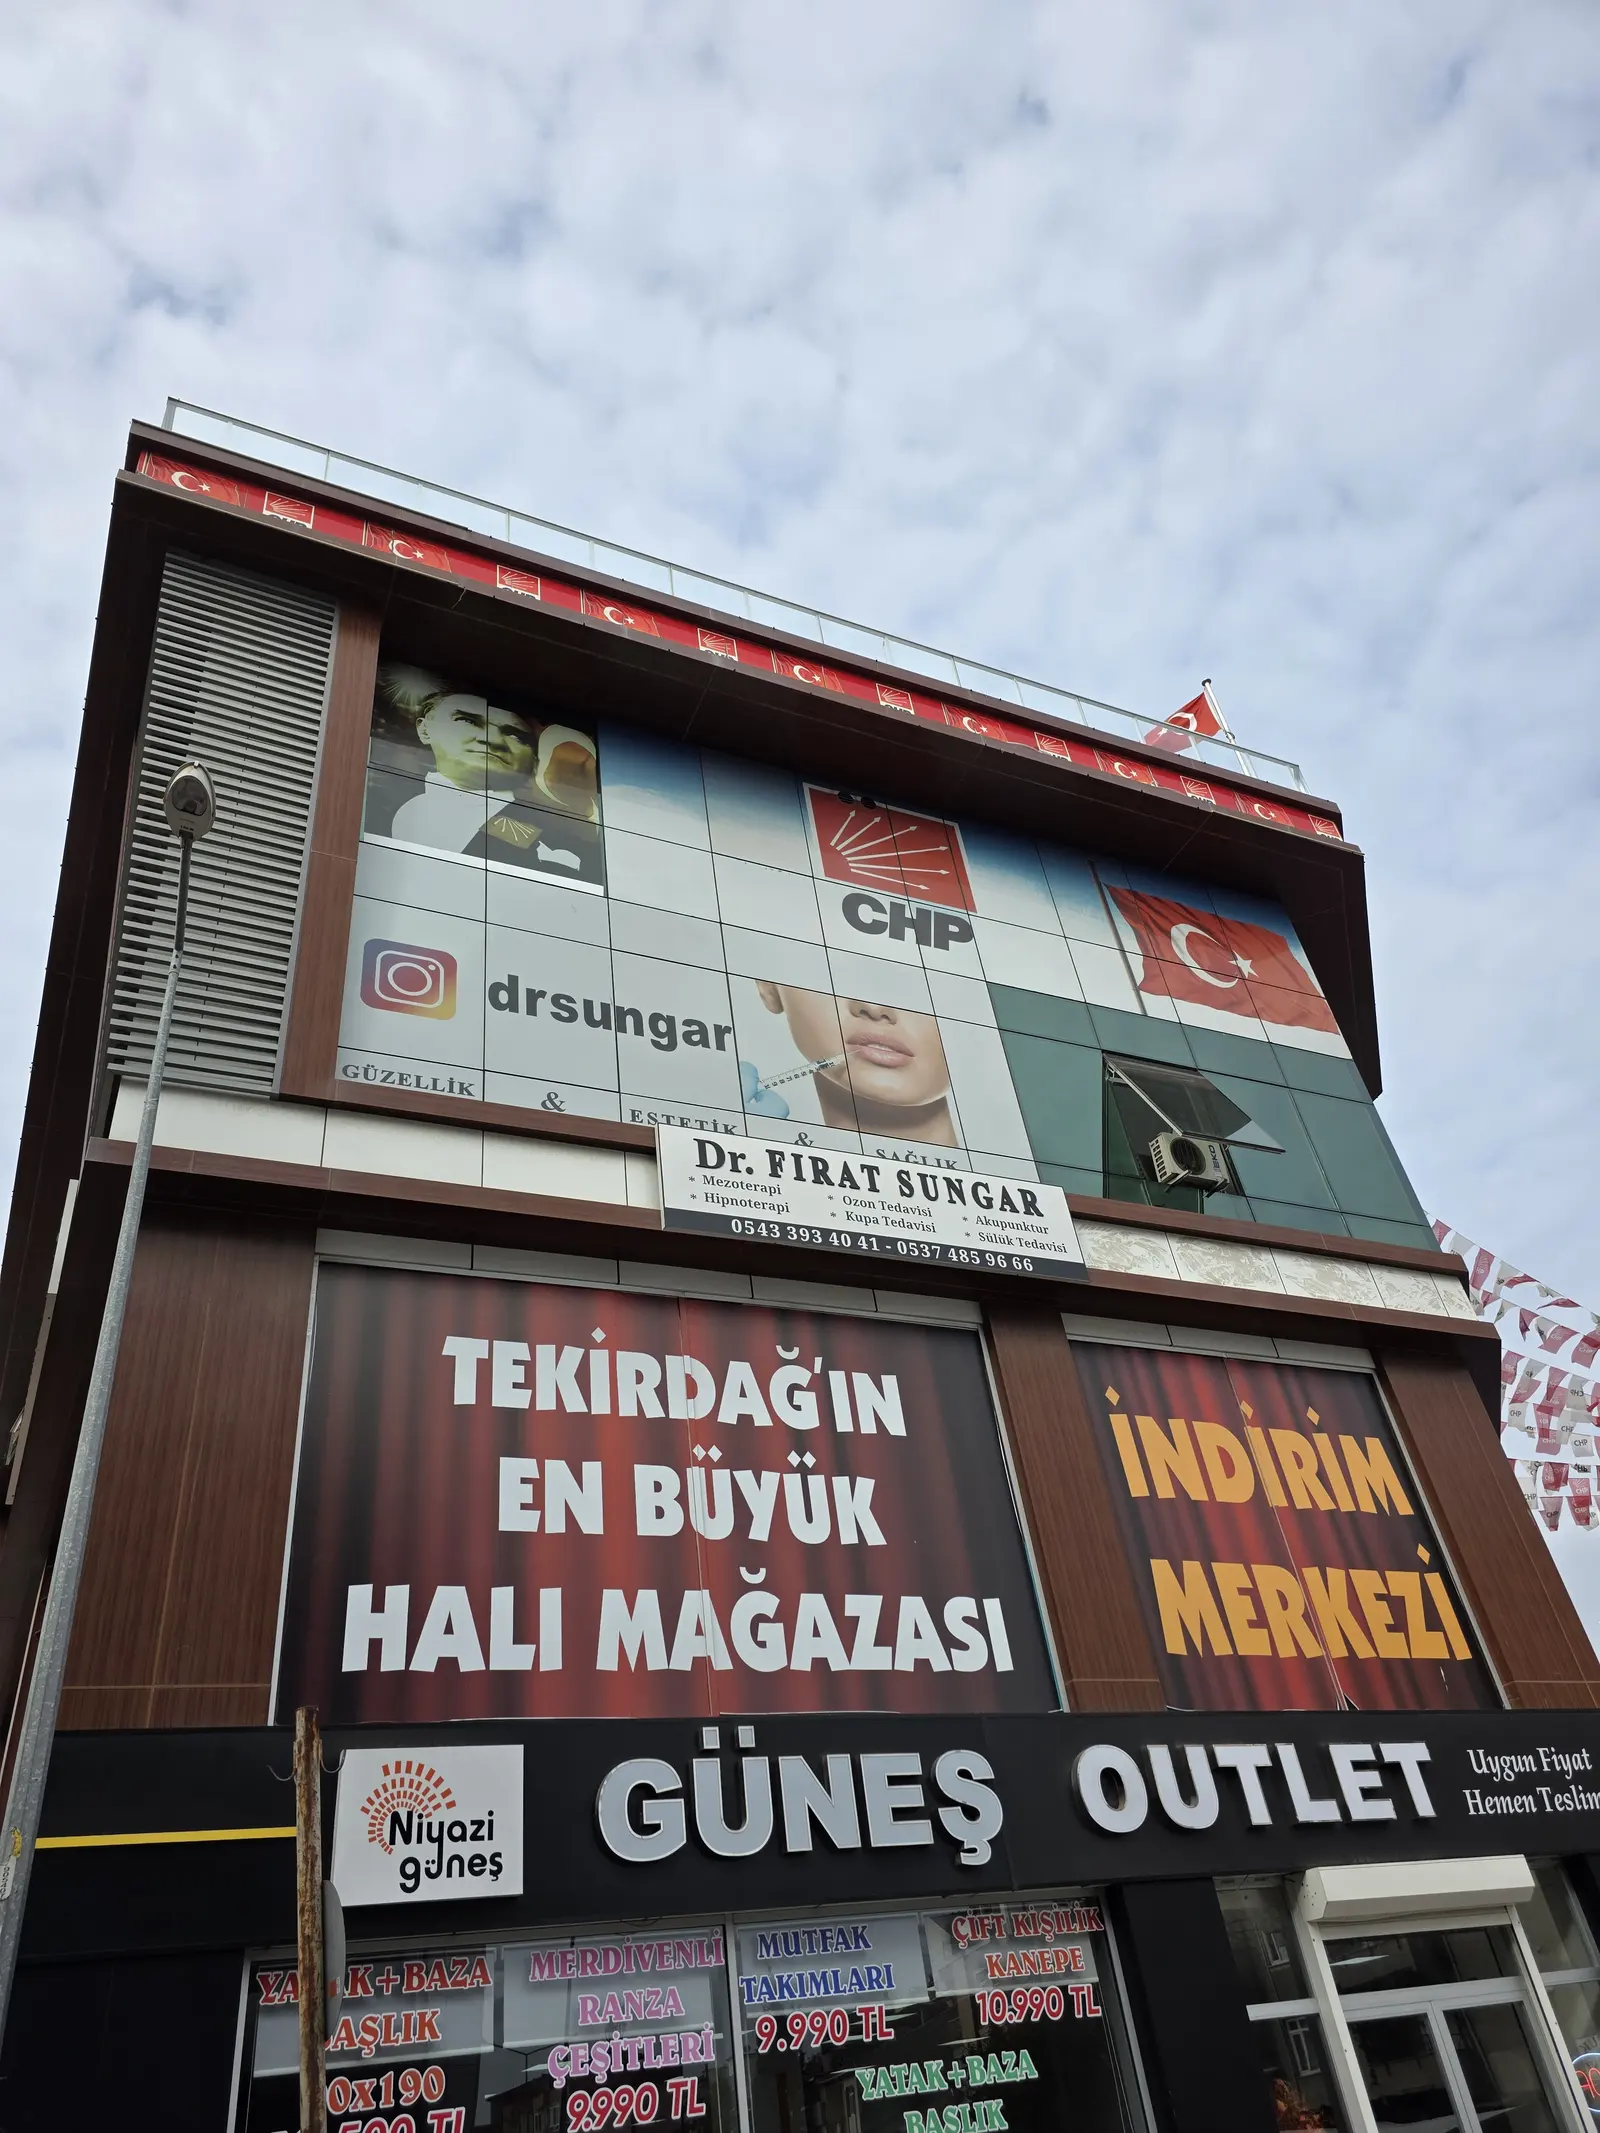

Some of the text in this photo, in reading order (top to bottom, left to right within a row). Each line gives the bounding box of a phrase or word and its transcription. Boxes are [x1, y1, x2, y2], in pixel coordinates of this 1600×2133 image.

[842, 892, 974, 952] CHP
[488, 974, 733, 1053] drsungar
[342, 1064, 475, 1098] GÜZELLİK
[541, 1092, 567, 1112] &
[693, 1138, 1045, 1219] Dr. FIRAT SUNGAR
[702, 1174, 782, 1196] Mezoterapi
[704, 1192, 790, 1215] Hipnoterapi
[842, 1196, 932, 1218] Ozon Tedavisi
[845, 1211, 937, 1233] Kupa Tedavisi
[975, 1215, 1049, 1235] Akupunktur
[731, 1218, 781, 1238] 0543
[786, 1226, 822, 1244] 393
[828, 1231, 851, 1247] 40
[857, 1236, 880, 1251] 41
[897, 1240, 941, 1259] 0537
[948, 1249, 981, 1264] 485
[986, 1253, 1008, 1268] 96
[1012, 1256, 1034, 1271] 66
[978, 1232, 1068, 1254] Sülük Tedavisi
[442, 1327, 907, 1437] TEKİRDAĞ'IN
[1105, 1385, 1415, 1516] İNDİRİM
[1573, 1439, 1588, 1447] CHP
[499, 1445, 888, 1546] EN BÜYÜK
[342, 1567, 1014, 1673] HALI MAĞAZASI
[1149, 1543, 1472, 1661] MERKEZİ
[1466, 1746, 1593, 1782] Uygun Fiyat
[597, 1725, 1437, 1867] GÜNEŞ OUTLET
[1462, 1789, 1537, 1815] Hemen
[389, 1810, 495, 1862] Niyazi
[399, 1852, 503, 1894] güneş
[755, 1923, 873, 1960] MUTFAK
[951, 1900, 1105, 1950] ÇİFT KİŞİLİK
[528, 1928, 726, 1983] MERDİVENLİ
[985, 1946, 1085, 1980] KANEPE
[577, 1985, 686, 2027] RANZA
[738, 1963, 896, 2005] TAKIMLARI
[975, 1983, 1102, 2026] 10.990 TL
[325, 2008, 442, 2058] AŞLIK
[755, 2004, 895, 2054] 9.990 TL
[547, 2021, 716, 2089] ÇEŞİTLERİ
[855, 2048, 1039, 2101] YATAK+BAZA
[566, 2076, 707, 2133] 9.990 TL
